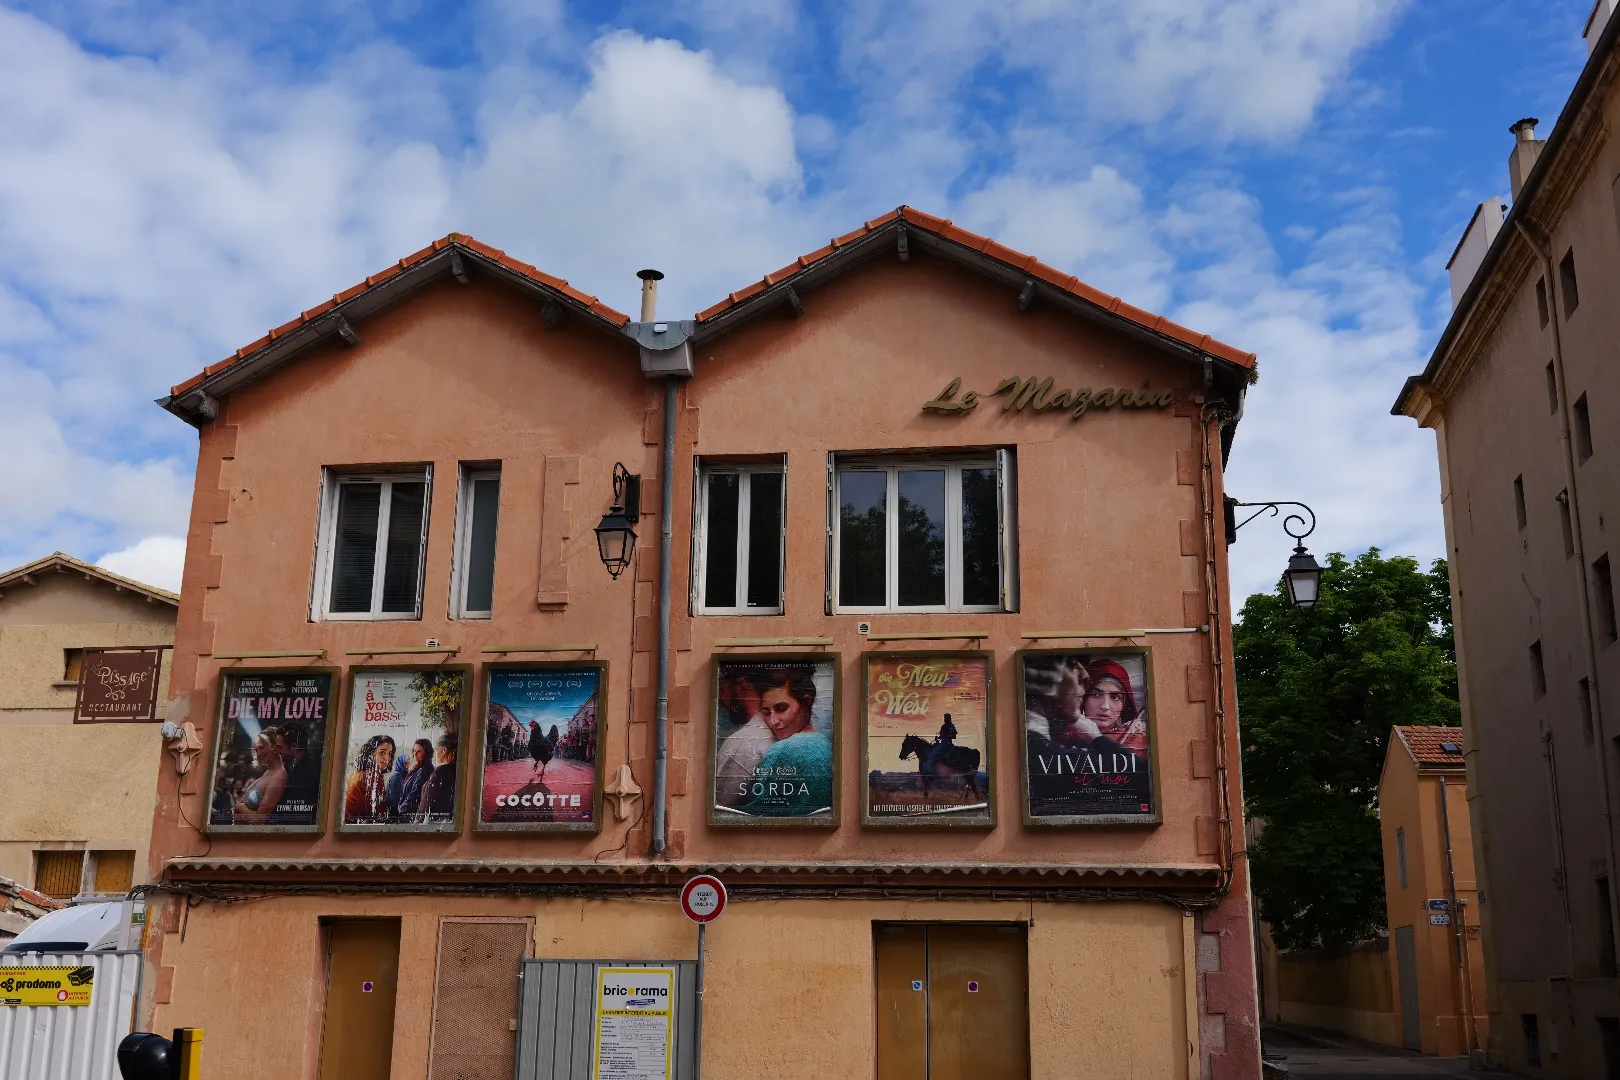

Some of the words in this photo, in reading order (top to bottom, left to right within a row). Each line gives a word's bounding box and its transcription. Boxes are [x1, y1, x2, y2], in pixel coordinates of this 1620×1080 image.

[922, 376, 980, 415] Le
[997, 375, 1174, 420] Mazarin
[879, 671, 893, 683] the
[897, 664, 950, 688] New
[365, 689, 375, 702] à
[874, 689, 930, 715] West
[88, 703, 142, 712] RESTAURANT
[228, 697, 255, 718] DIE
[257, 697, 283, 718] MY
[285, 697, 324, 718] LOVE
[366, 699, 397, 711] voix
[364, 708, 407, 722] basse
[1038, 753, 1136, 774] VIVALDI
[738, 782, 810, 796] SORDA
[495, 792, 581, 807] COCOTTE
[15, 979, 61, 992] prodomo
